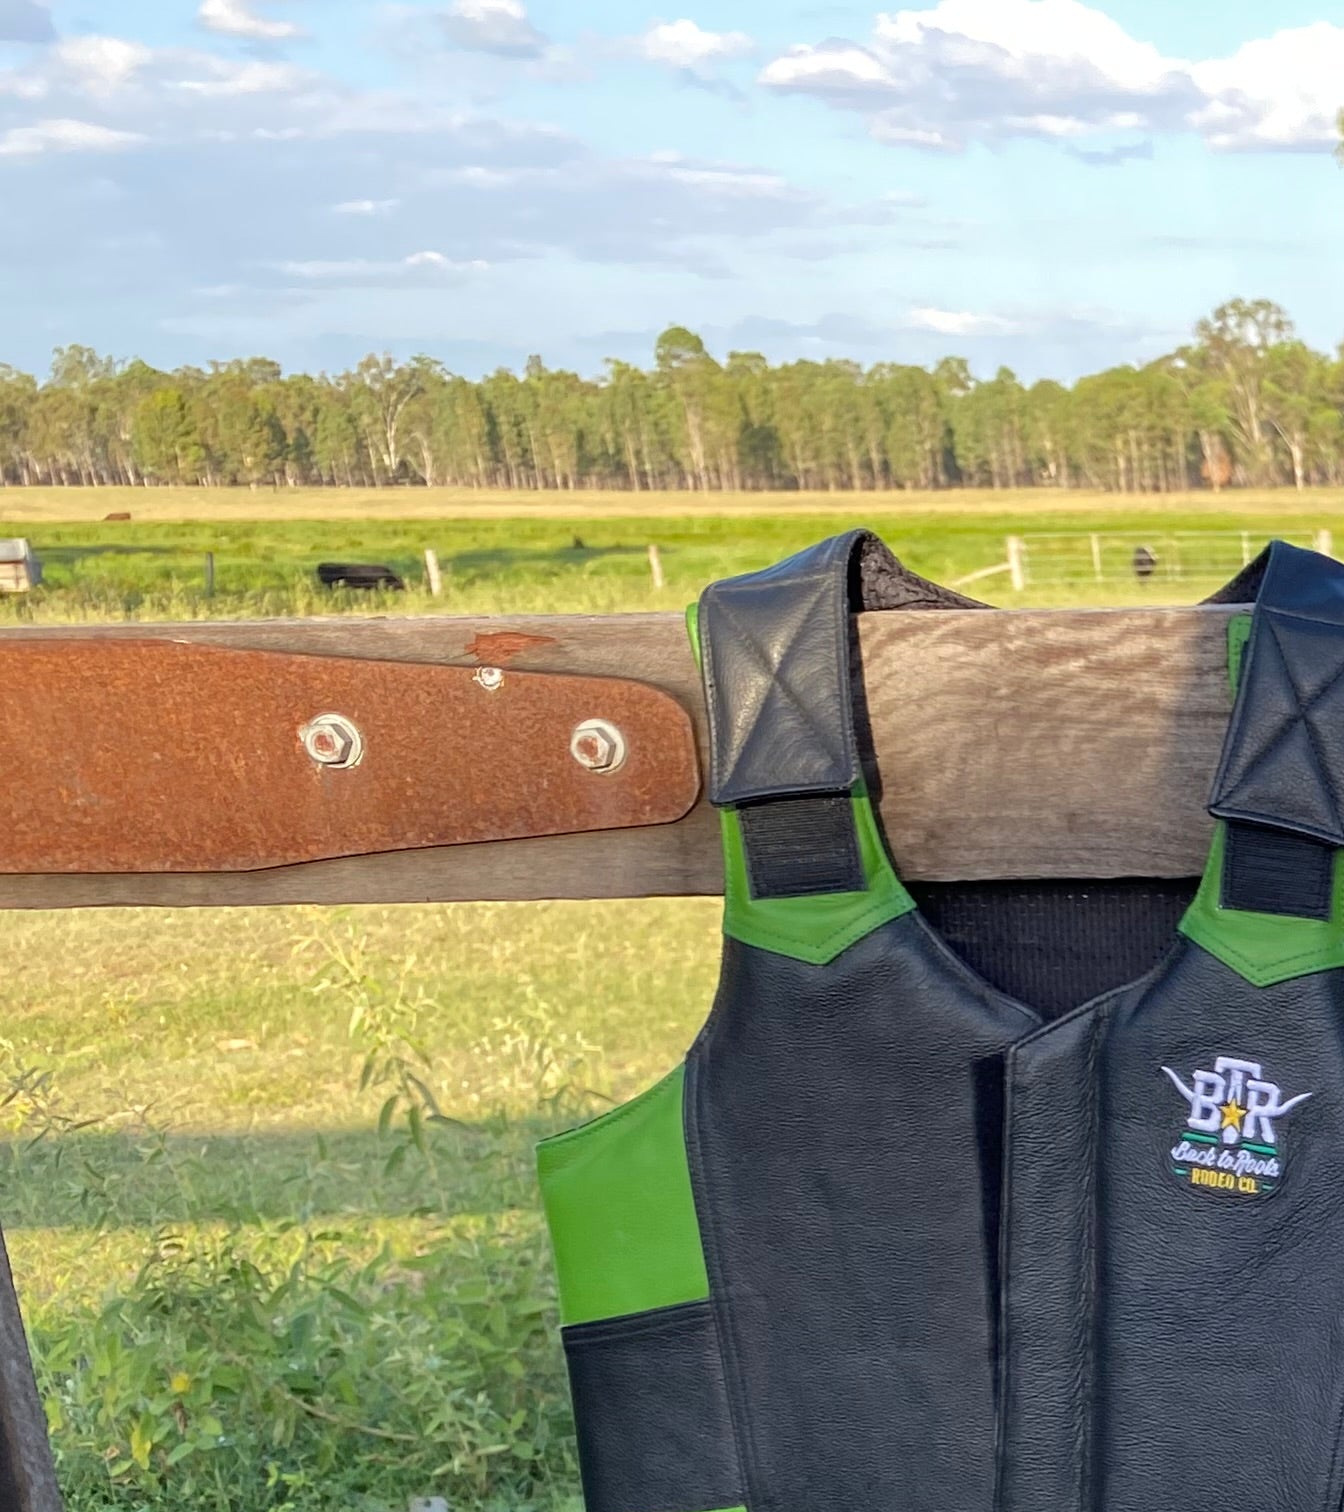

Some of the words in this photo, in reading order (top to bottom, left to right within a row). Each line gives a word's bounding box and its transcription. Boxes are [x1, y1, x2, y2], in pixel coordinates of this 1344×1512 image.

[1187, 1056, 1280, 1144] BTR
[1171, 1141, 1217, 1167] Back
[1217, 1150, 1236, 1168] to
[1234, 1150, 1280, 1177] Roots
[1191, 1167, 1236, 1190] RODEO
